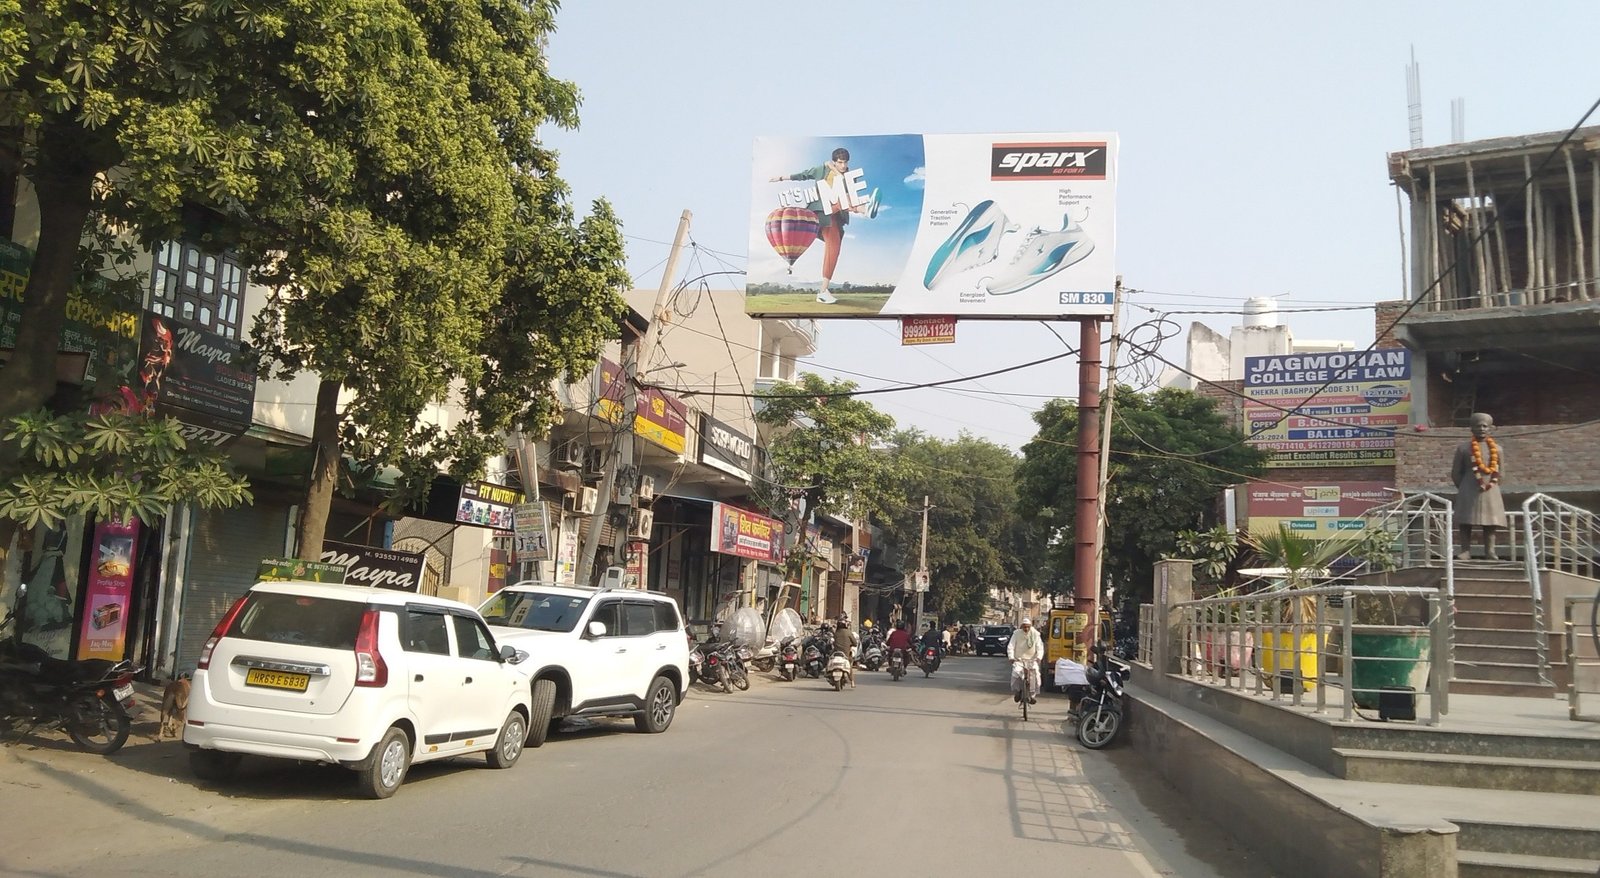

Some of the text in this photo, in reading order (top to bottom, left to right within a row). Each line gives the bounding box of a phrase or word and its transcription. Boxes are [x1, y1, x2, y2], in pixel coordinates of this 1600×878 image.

[998, 149, 1100, 173] sparx
[803, 186, 819, 204] IN
[816, 168, 871, 216] ME
[1061, 293, 1106, 304] SM 830
[904, 323, 954, 338] 99920-11223
[177, 328, 232, 365] Mayra
[1251, 351, 1405, 373] JAGMOHAN
[1250, 366, 1406, 384] COLLEGE OF LAW
[1250, 388, 1279, 396] KHEKRA
[1293, 451, 1328, 460] Excellent
[1330, 451, 1357, 459] Results
[1360, 450, 1380, 458] Since
[478, 484, 492, 500] FIT
[1320, 489, 1338, 498] pnb
[374, 552, 419, 564] 9355314986
[253, 672, 306, 688] HR69 E 6838
